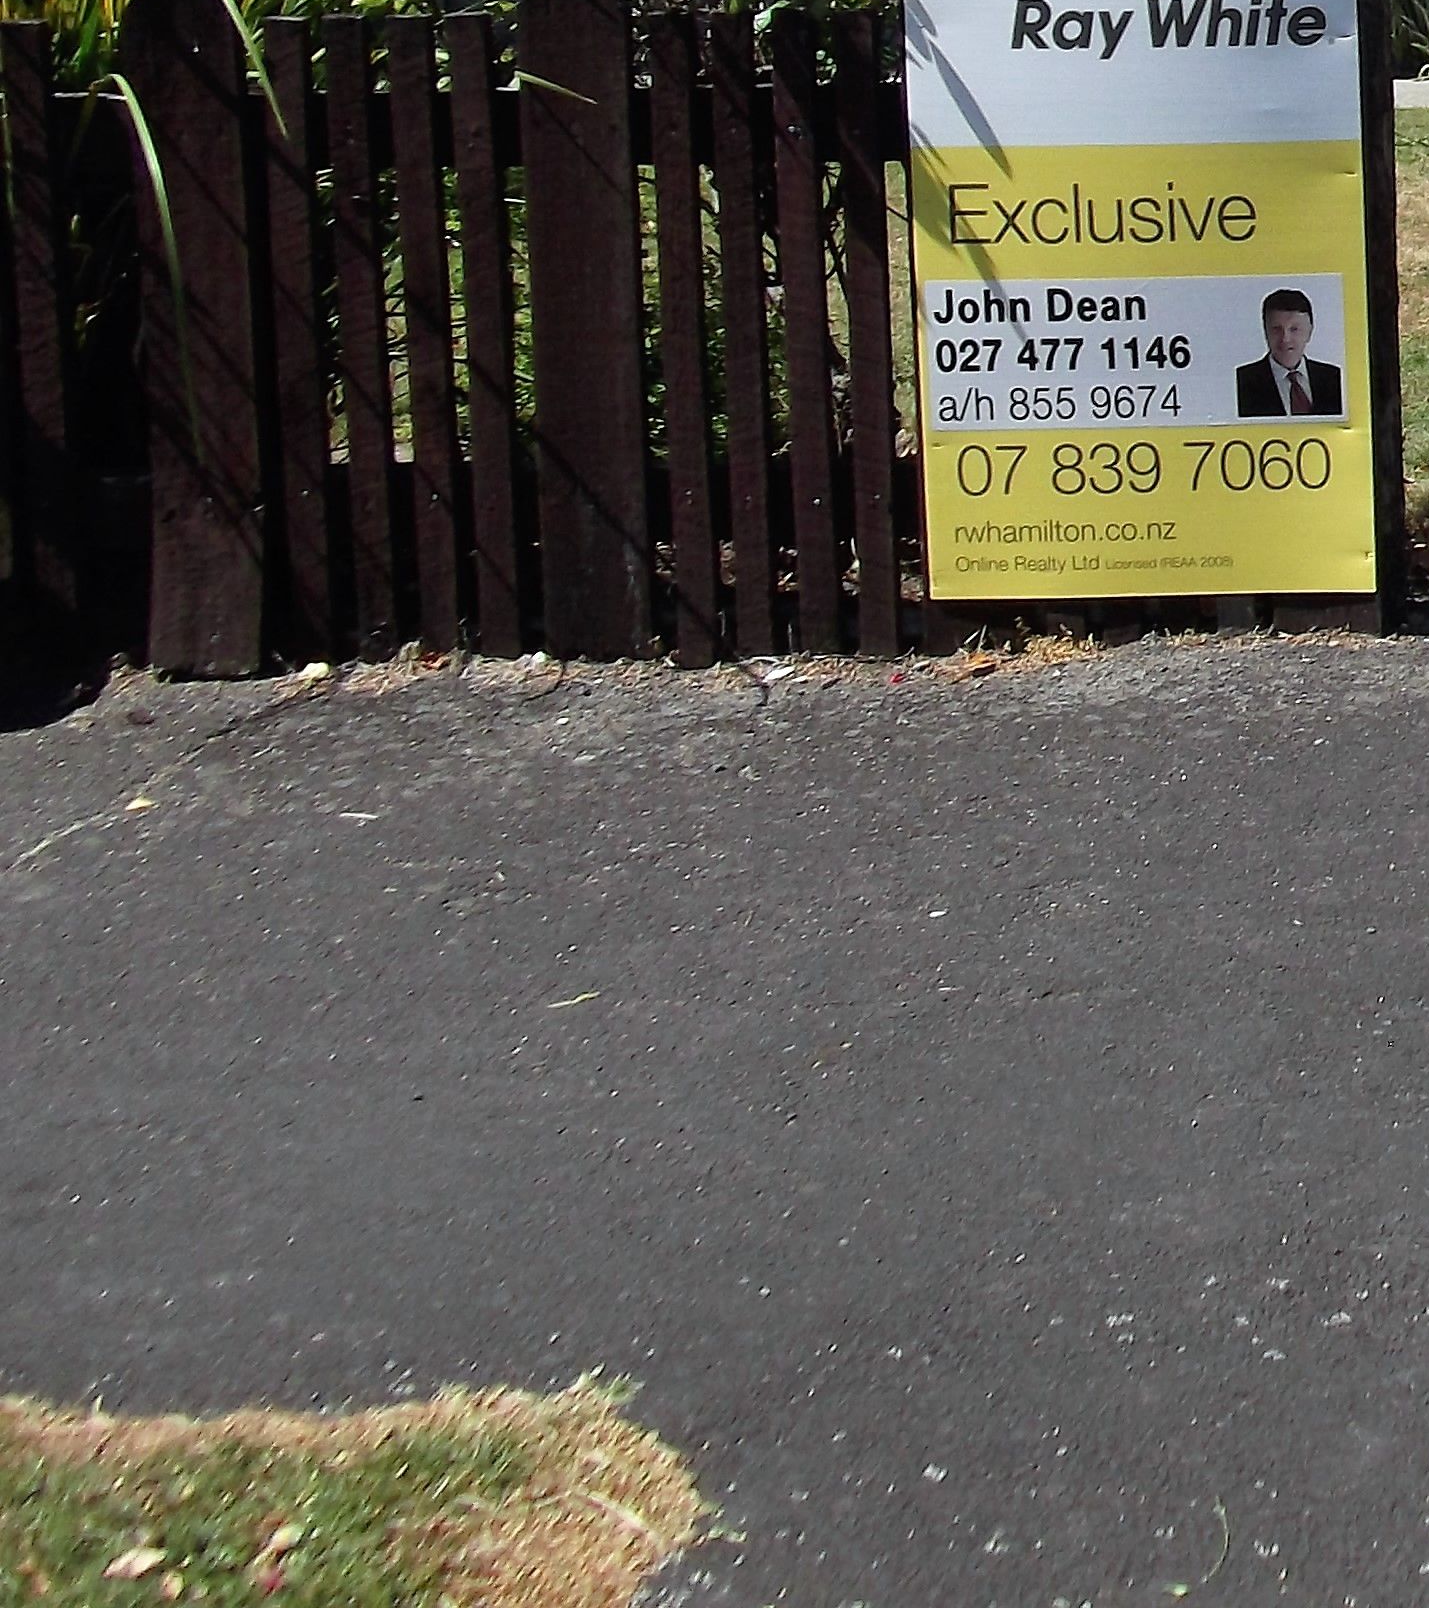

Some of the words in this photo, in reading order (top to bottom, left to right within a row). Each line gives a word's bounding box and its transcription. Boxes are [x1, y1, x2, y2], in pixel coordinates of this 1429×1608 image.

[948, 181, 1257, 245] Exclusive
[933, 289, 1030, 324] John
[1047, 288, 1147, 323] Dean
[936, 338, 1003, 373] 027
[1017, 337, 1085, 372] 477
[1101, 335, 1192, 370] 1146
[939, 387, 994, 422] a/h
[1010, 387, 1076, 421] 855
[1091, 385, 1182, 420] 9674
[957, 444, 1028, 497] 07
[1052, 441, 1161, 495] 839
[1183, 438, 1331, 492] 7060
[955, 519, 1177, 544] rwhamilton.co.nz
[955, 555, 1009, 572] Online
[1014, 555, 1066, 575] Realty
[1072, 554, 1100, 571] Ltd
